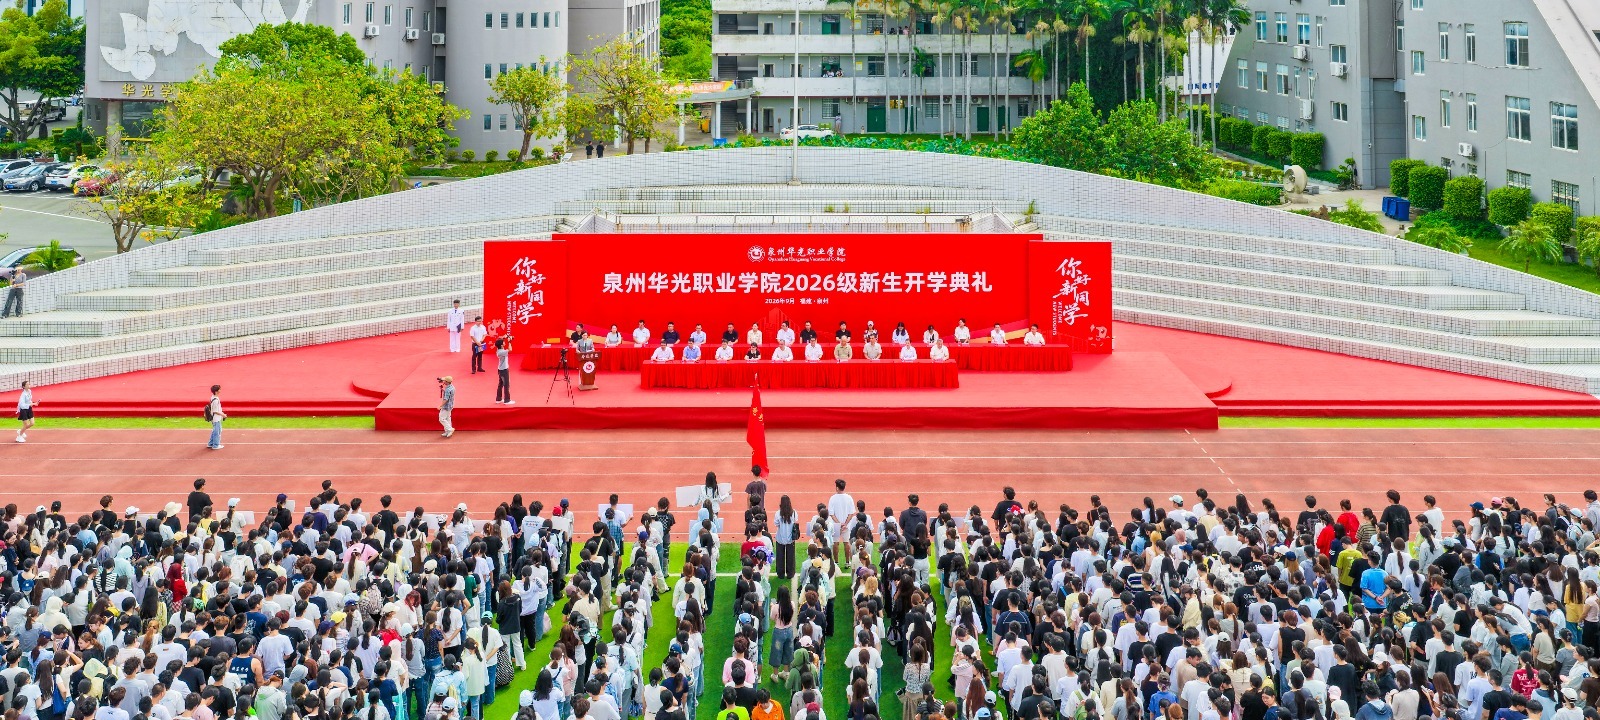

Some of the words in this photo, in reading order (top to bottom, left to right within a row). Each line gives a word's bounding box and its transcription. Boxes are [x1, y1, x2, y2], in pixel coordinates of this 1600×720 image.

[767, 246, 846, 257] 泉州华光职业学院
[602, 271, 993, 294] 泉州华光职业学院2026级新生开学典礼
[764, 297, 795, 305] 2026年9月
